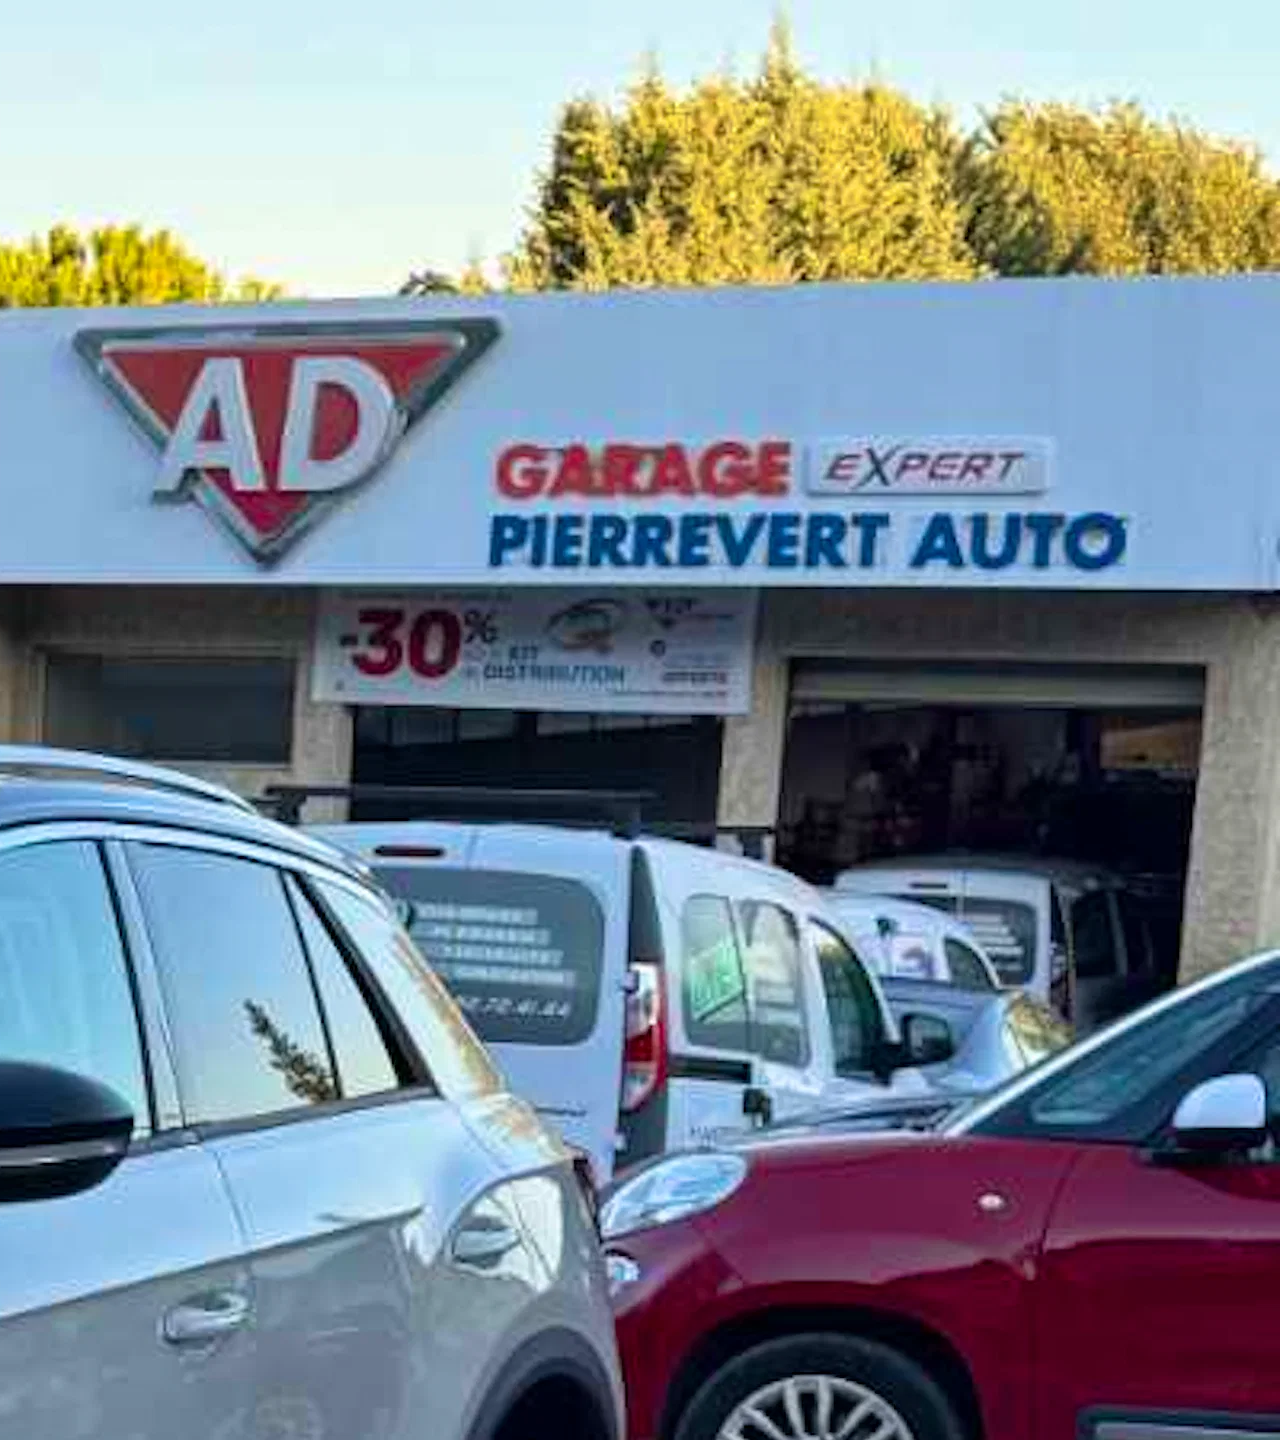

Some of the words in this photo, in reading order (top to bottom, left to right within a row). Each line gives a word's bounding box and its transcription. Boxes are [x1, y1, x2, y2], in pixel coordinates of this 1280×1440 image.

[152, 355, 407, 503] AD
[494, 441, 791, 498] GARAGE
[488, 512, 889, 568] PIERREVERT
[911, 511, 1128, 569] AUTO
